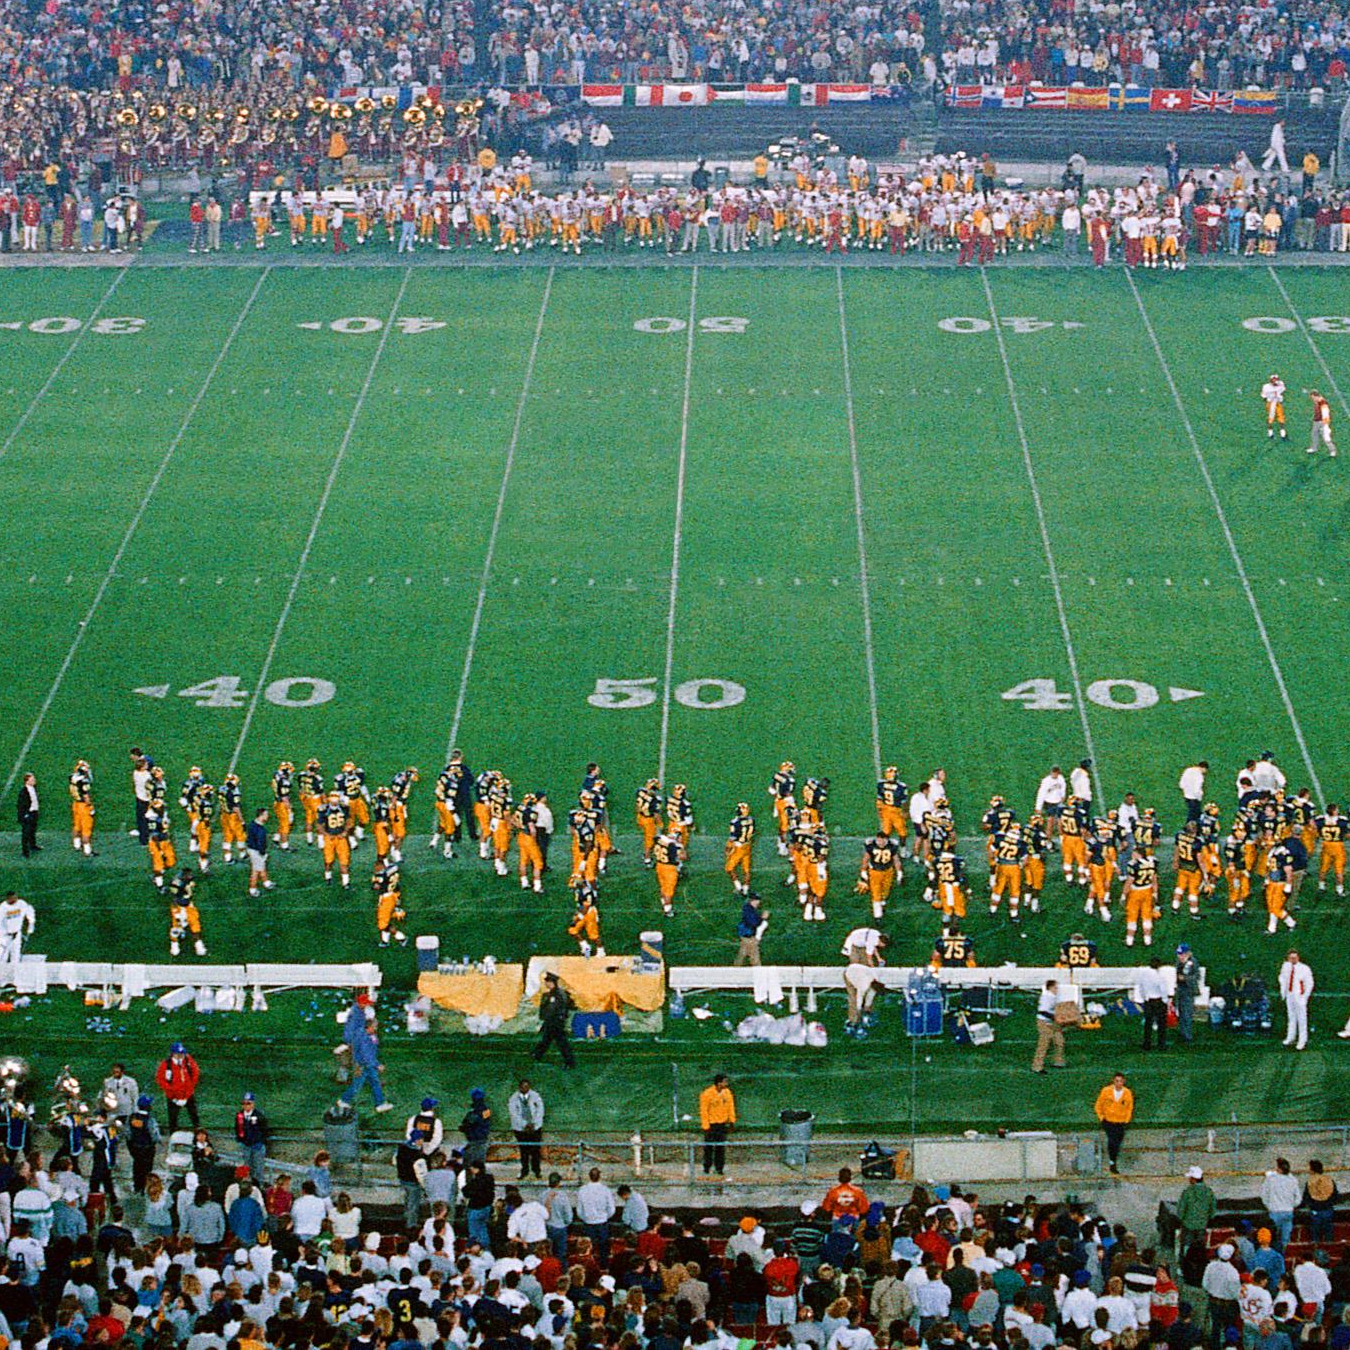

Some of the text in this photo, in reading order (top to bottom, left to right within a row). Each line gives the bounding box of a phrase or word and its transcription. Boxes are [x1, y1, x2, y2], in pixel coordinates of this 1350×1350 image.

[27, 317, 147, 335] 30
[329, 317, 447, 335] 40
[632, 317, 749, 334] 50
[937, 317, 1054, 334] 40
[178, 676, 336, 707] 40
[587, 678, 746, 709] 50
[1001, 678, 1159, 710] 40
[884, 790, 894, 806] 9
[327, 811, 344, 829] 66
[999, 818, 1010, 832] 7
[1062, 816, 1077, 835] 50
[1135, 827, 1153, 845] 44
[873, 849, 891, 864] 78
[999, 840, 1018, 860] 72
[1178, 843, 1193, 861] 51
[943, 940, 965, 959] 75
[1068, 945, 1089, 965] 69
[399, 1299, 411, 1322] 3
